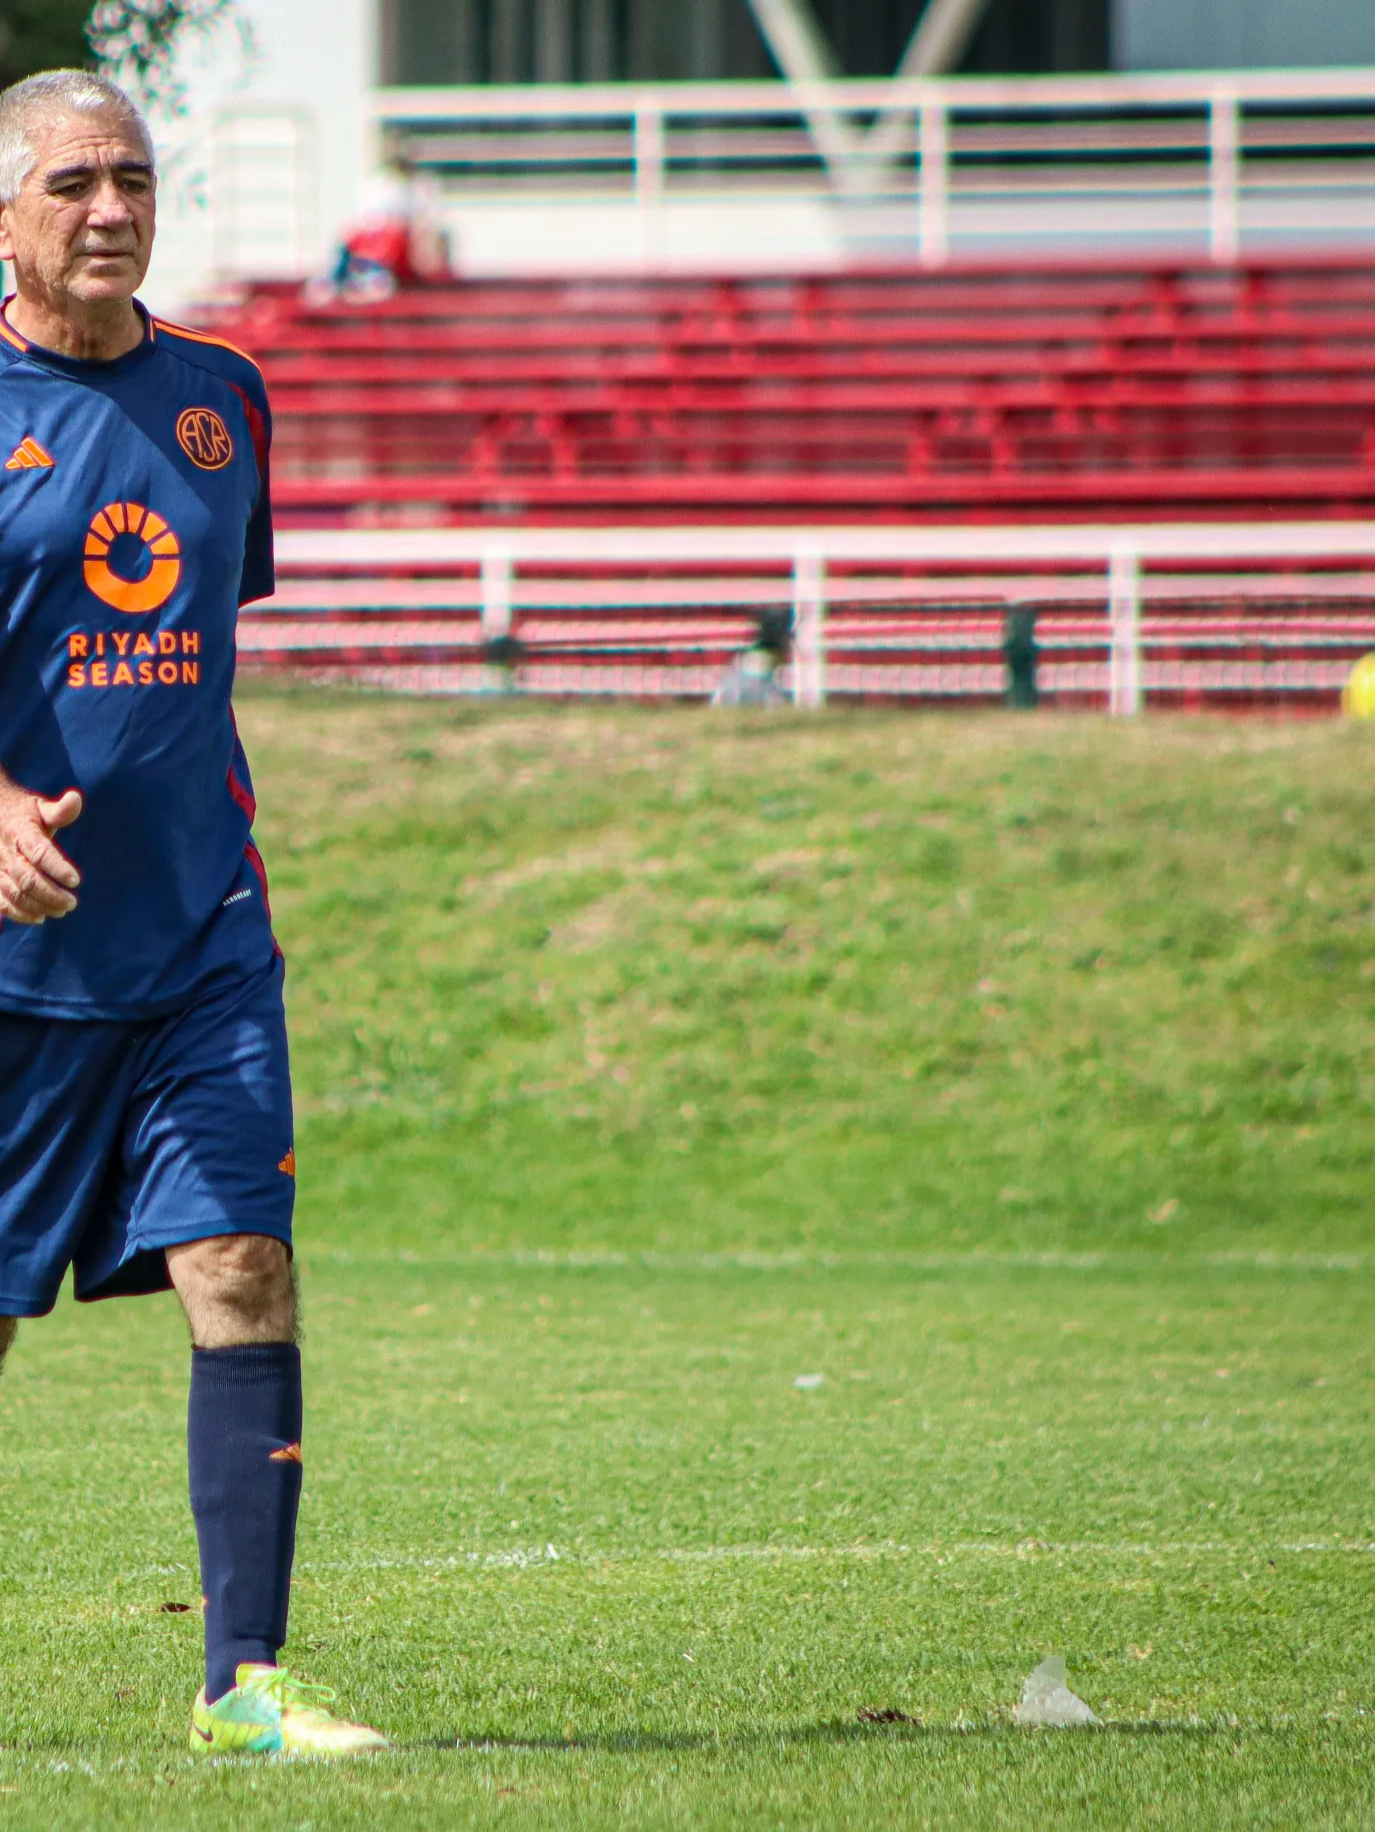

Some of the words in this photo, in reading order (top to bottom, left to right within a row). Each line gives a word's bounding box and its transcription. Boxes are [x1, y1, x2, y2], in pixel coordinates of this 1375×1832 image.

[182, 411, 228, 463] ASR
[69, 631, 199, 657] RIYADH
[67, 662, 199, 688] SEASON
